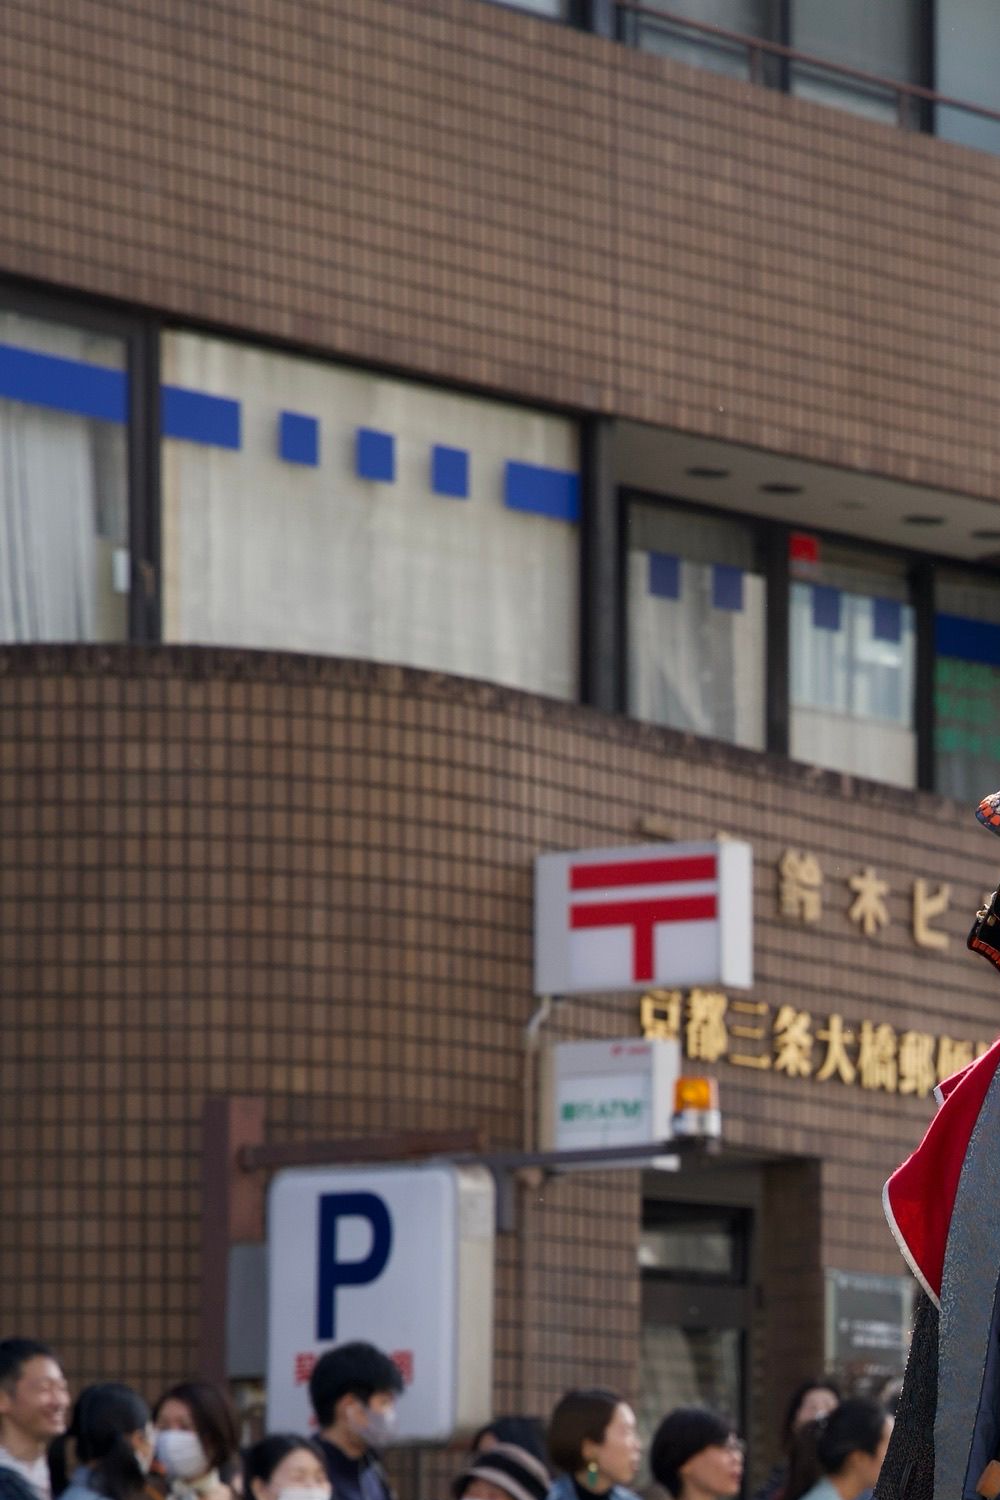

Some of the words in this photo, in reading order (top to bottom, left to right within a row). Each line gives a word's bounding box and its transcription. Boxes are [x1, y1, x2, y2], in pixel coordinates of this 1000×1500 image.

[780, 848, 994, 948] 鈴木ビ
[640, 988, 990, 1099] 京都三条大橋郵便
[315, 1190, 392, 1342] P
